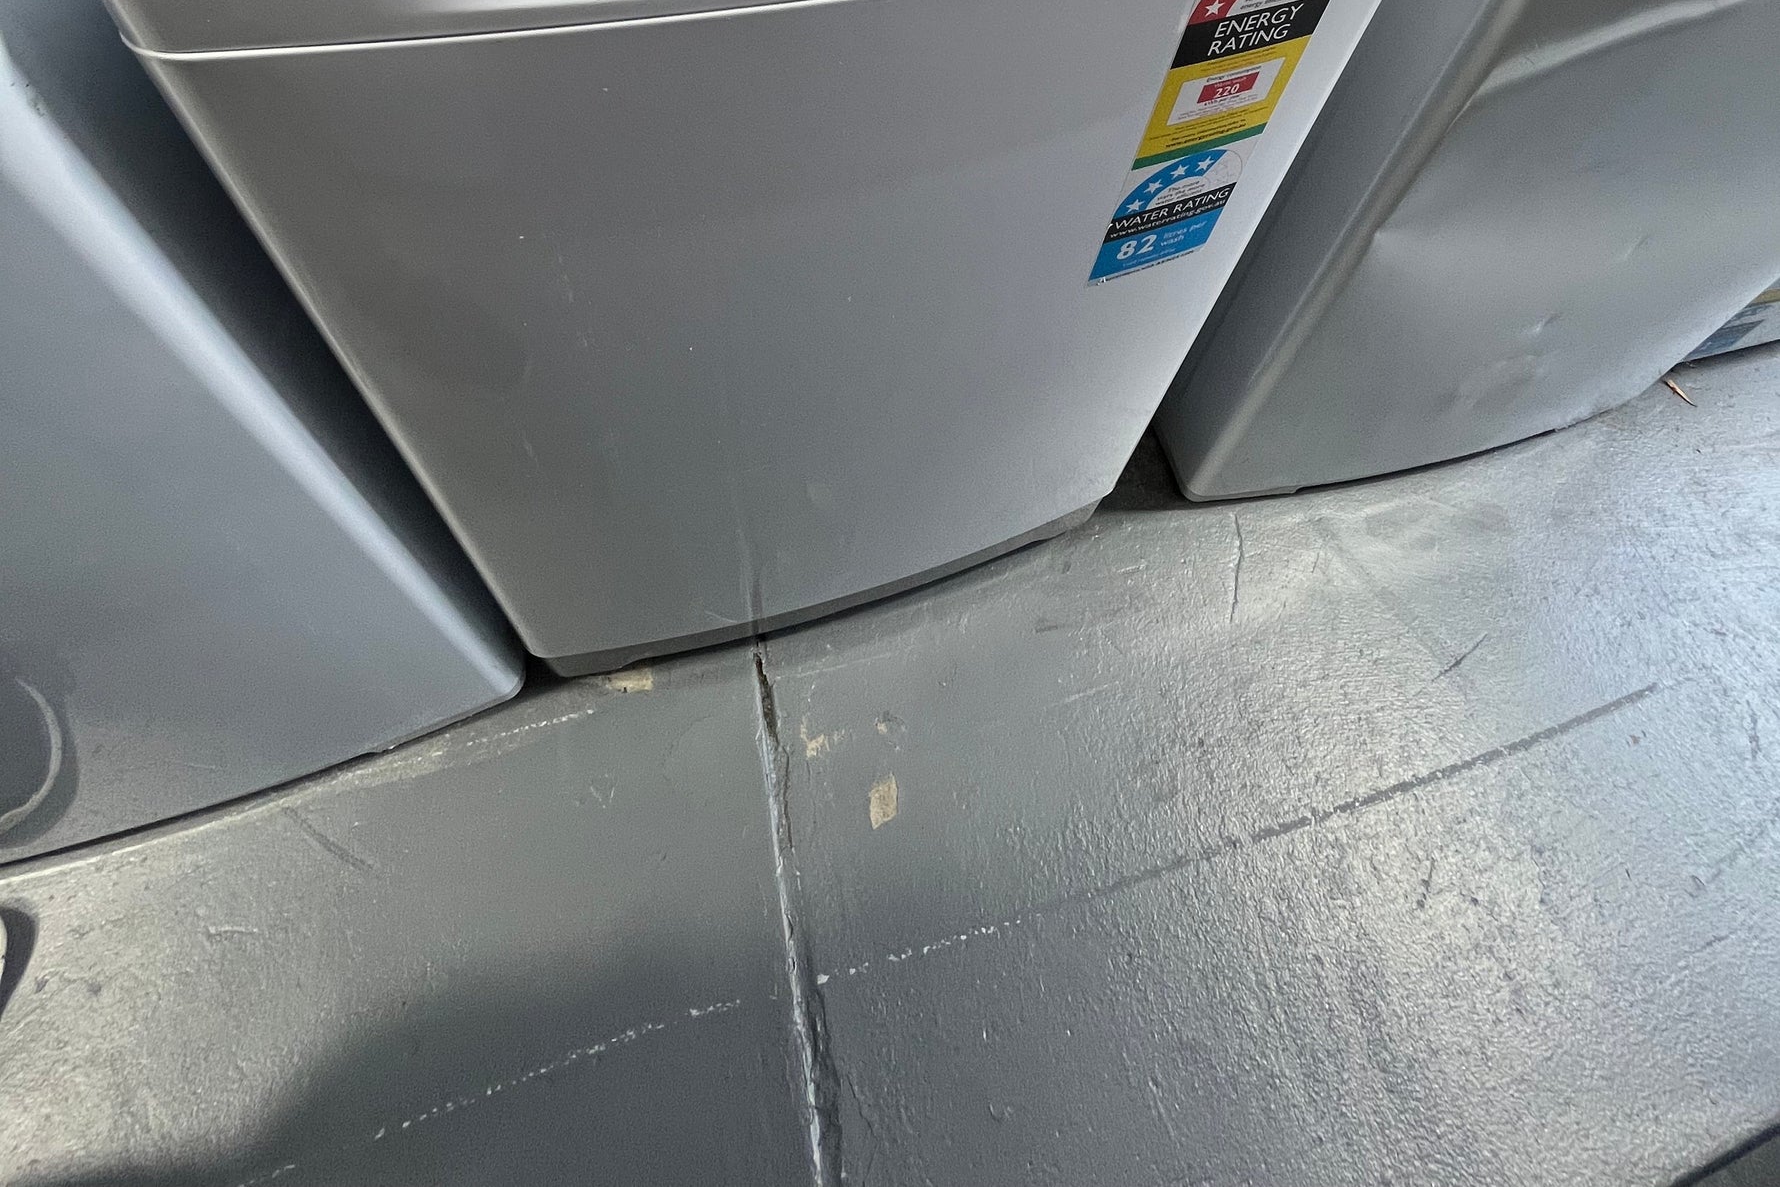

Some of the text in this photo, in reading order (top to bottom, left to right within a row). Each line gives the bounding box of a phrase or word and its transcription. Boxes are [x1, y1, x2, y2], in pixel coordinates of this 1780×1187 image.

[1239, 1, 1265, 11] energy
[1214, 3, 1304, 39] ENERGY
[1207, 23, 1291, 57] RATING
[1214, 83, 1241, 99] 220
[1114, 187, 1231, 230] WATER RATING
[1188, 220, 1209, 235] per
[1116, 234, 1158, 261] 82
[1160, 235, 1186, 247] wash
